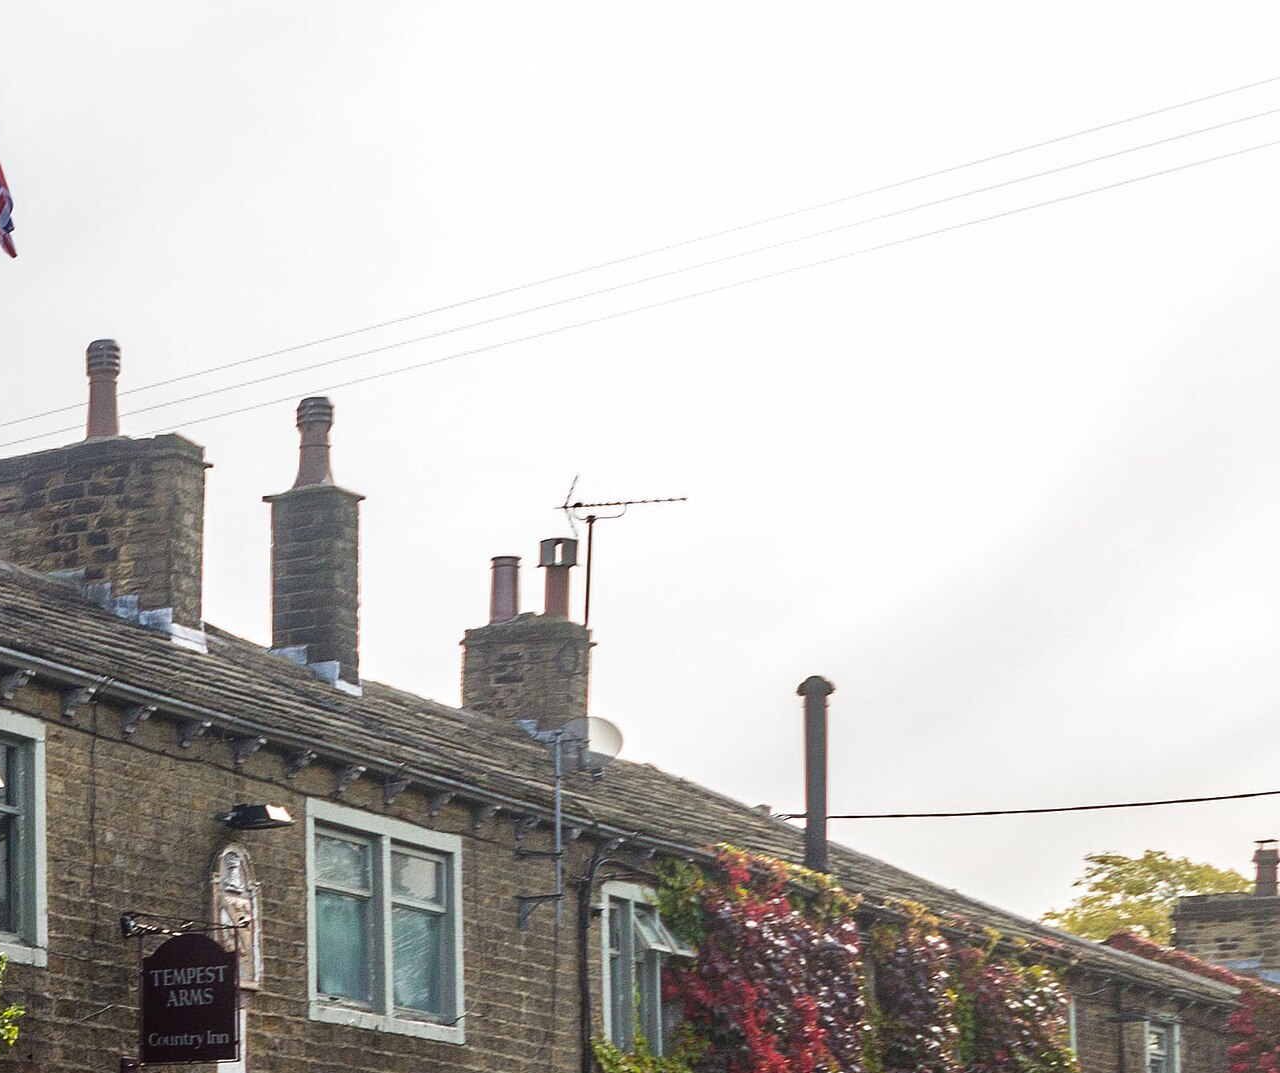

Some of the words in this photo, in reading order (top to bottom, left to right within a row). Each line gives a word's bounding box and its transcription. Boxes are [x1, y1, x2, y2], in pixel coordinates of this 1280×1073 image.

[149, 965, 228, 987] TEMPEST
[166, 987, 214, 1007] ARMS
[148, 1032, 203, 1050] Country
[207, 1030, 229, 1045] Inn
